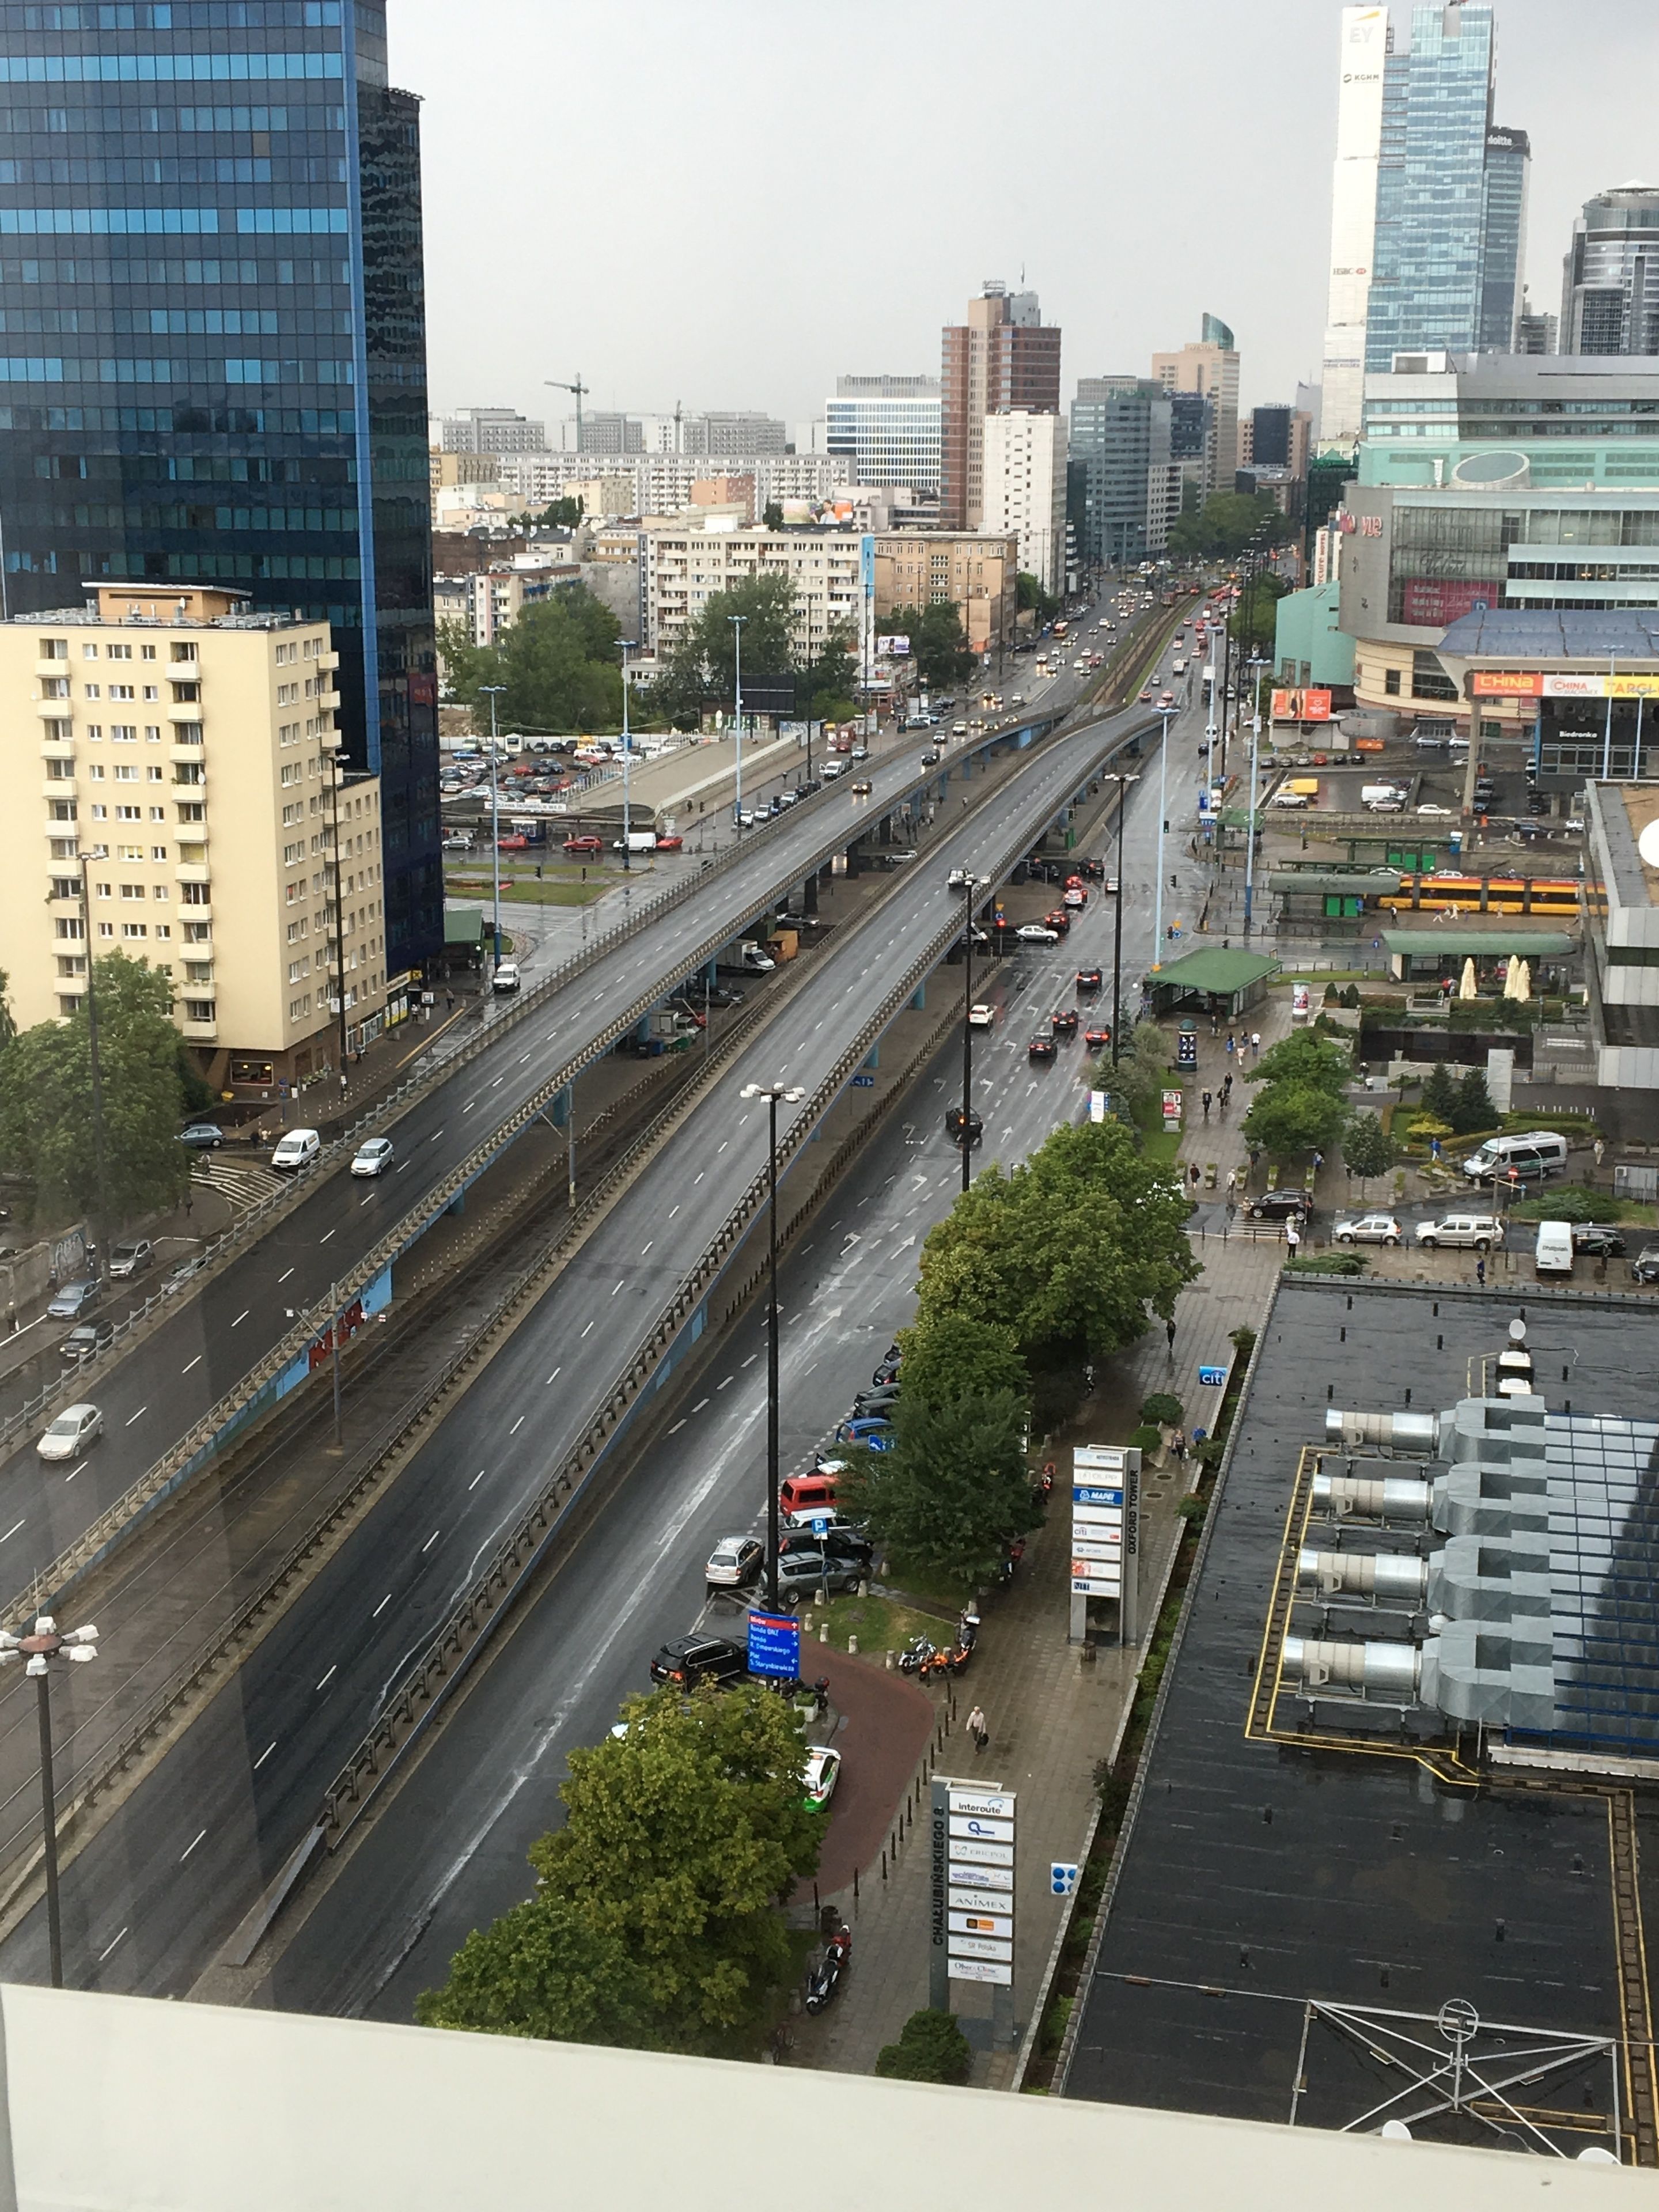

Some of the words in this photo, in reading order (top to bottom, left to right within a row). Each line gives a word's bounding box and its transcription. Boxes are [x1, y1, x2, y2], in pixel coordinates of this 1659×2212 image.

[1350, 26, 1374, 43] EY
[1554, 681, 1587, 690] CHINA
[1129, 1469, 1138, 1508] TOWER
[1090, 1492, 1115, 1501] MAPEI
[815, 1520, 824, 1531] P
[1074, 1527, 1087, 1535] citi
[1128, 1511, 1137, 1555] OXFORD
[933, 1806, 945, 1816] 8
[931, 1820, 945, 1946] CHAŁUBIŃSKIEGO
